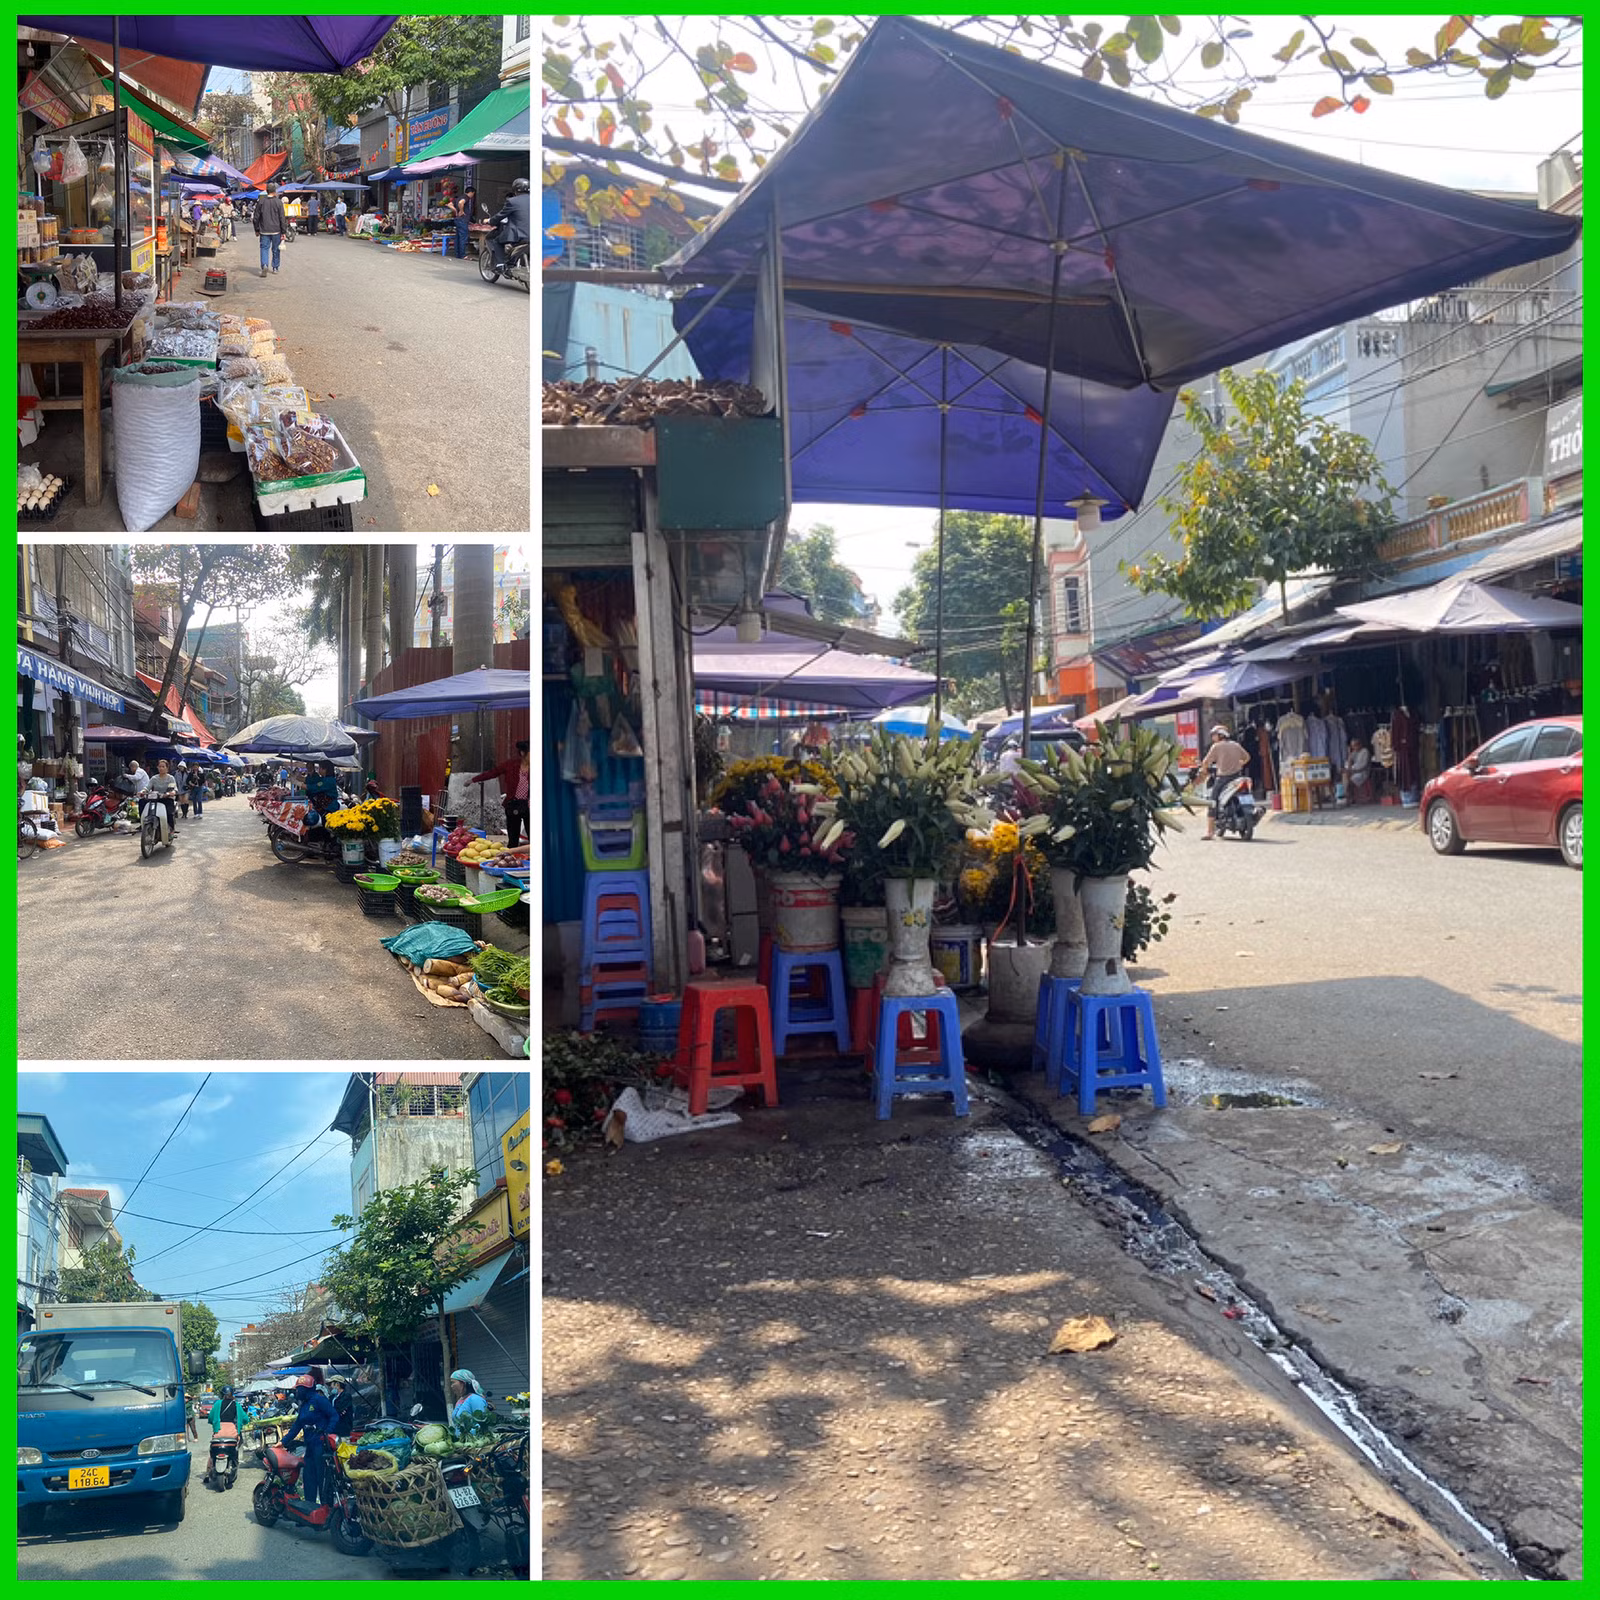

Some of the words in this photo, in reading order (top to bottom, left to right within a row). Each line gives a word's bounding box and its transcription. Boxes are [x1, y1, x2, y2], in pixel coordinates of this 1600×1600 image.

[38, 662, 75, 689] HÀNG
[79, 680, 101, 701] VINH
[80, 1468, 98, 1477] 24C
[74, 1477, 105, 1488] 118.64
